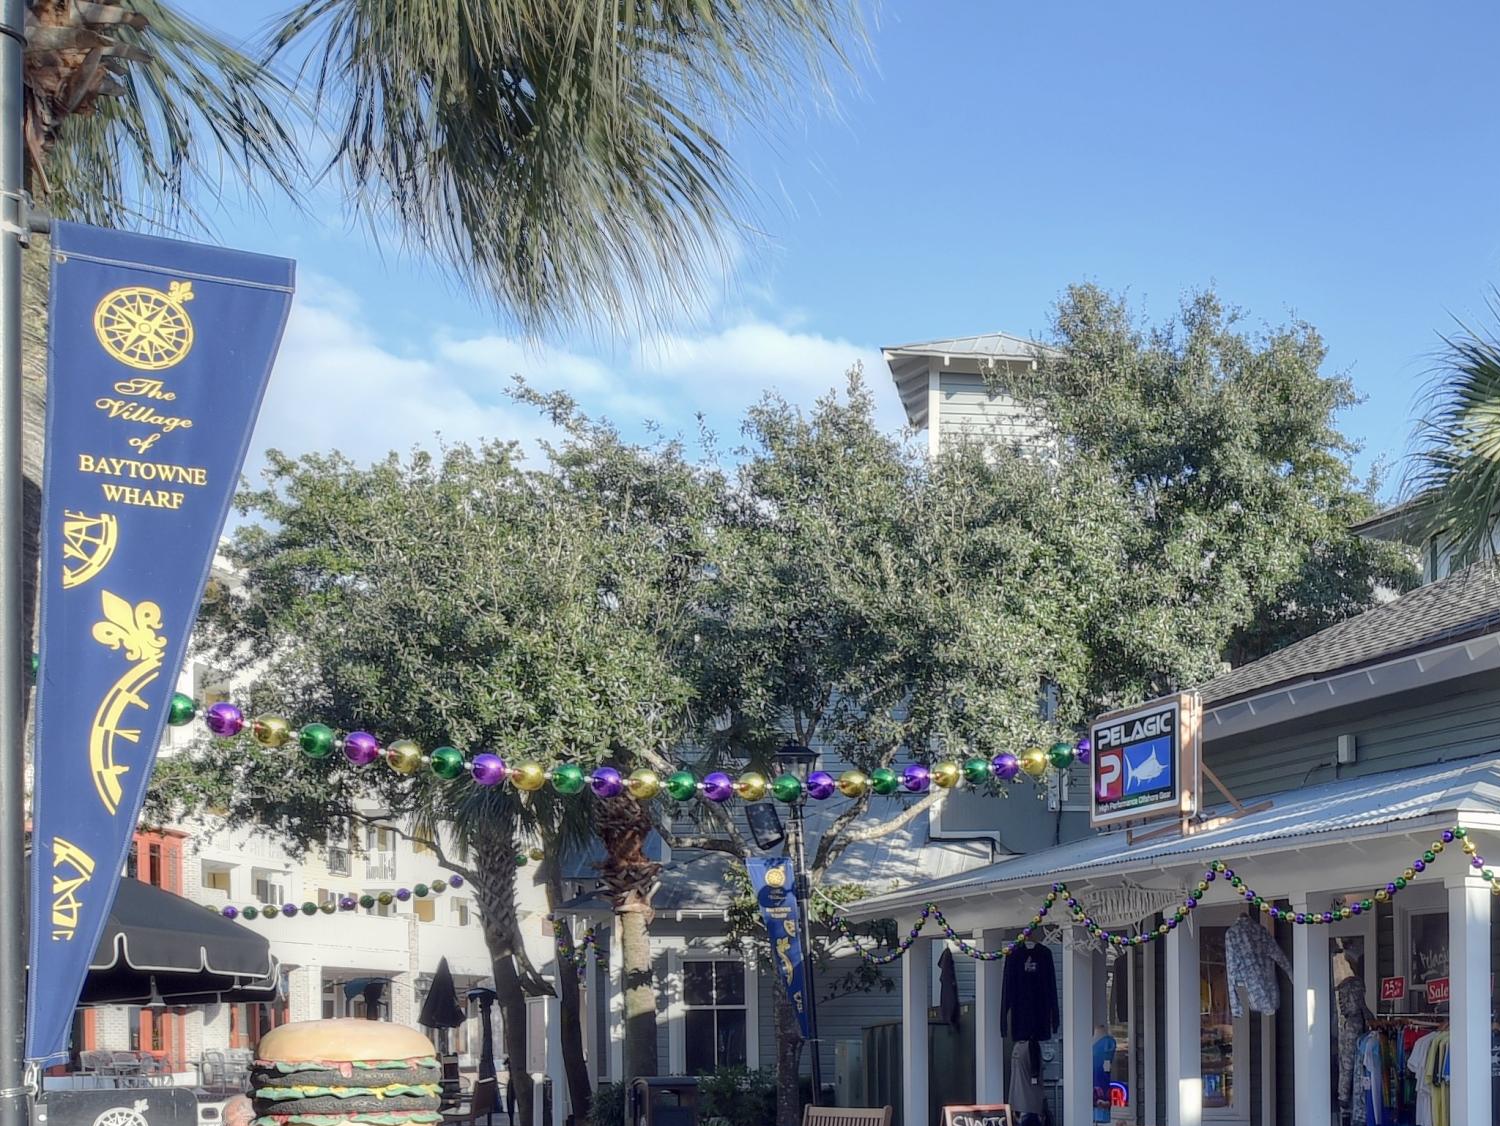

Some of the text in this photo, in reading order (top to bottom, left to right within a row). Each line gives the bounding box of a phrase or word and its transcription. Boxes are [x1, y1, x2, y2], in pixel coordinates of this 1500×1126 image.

[114, 378, 176, 401] The
[95, 398, 193, 432] Village
[129, 433, 161, 453] of
[79, 454, 207, 485] BAYTOWNE
[103, 484, 184, 509] WHARF
[1097, 712, 1171, 749] PELAGIC
[1429, 984, 1449, 1000] Sale
